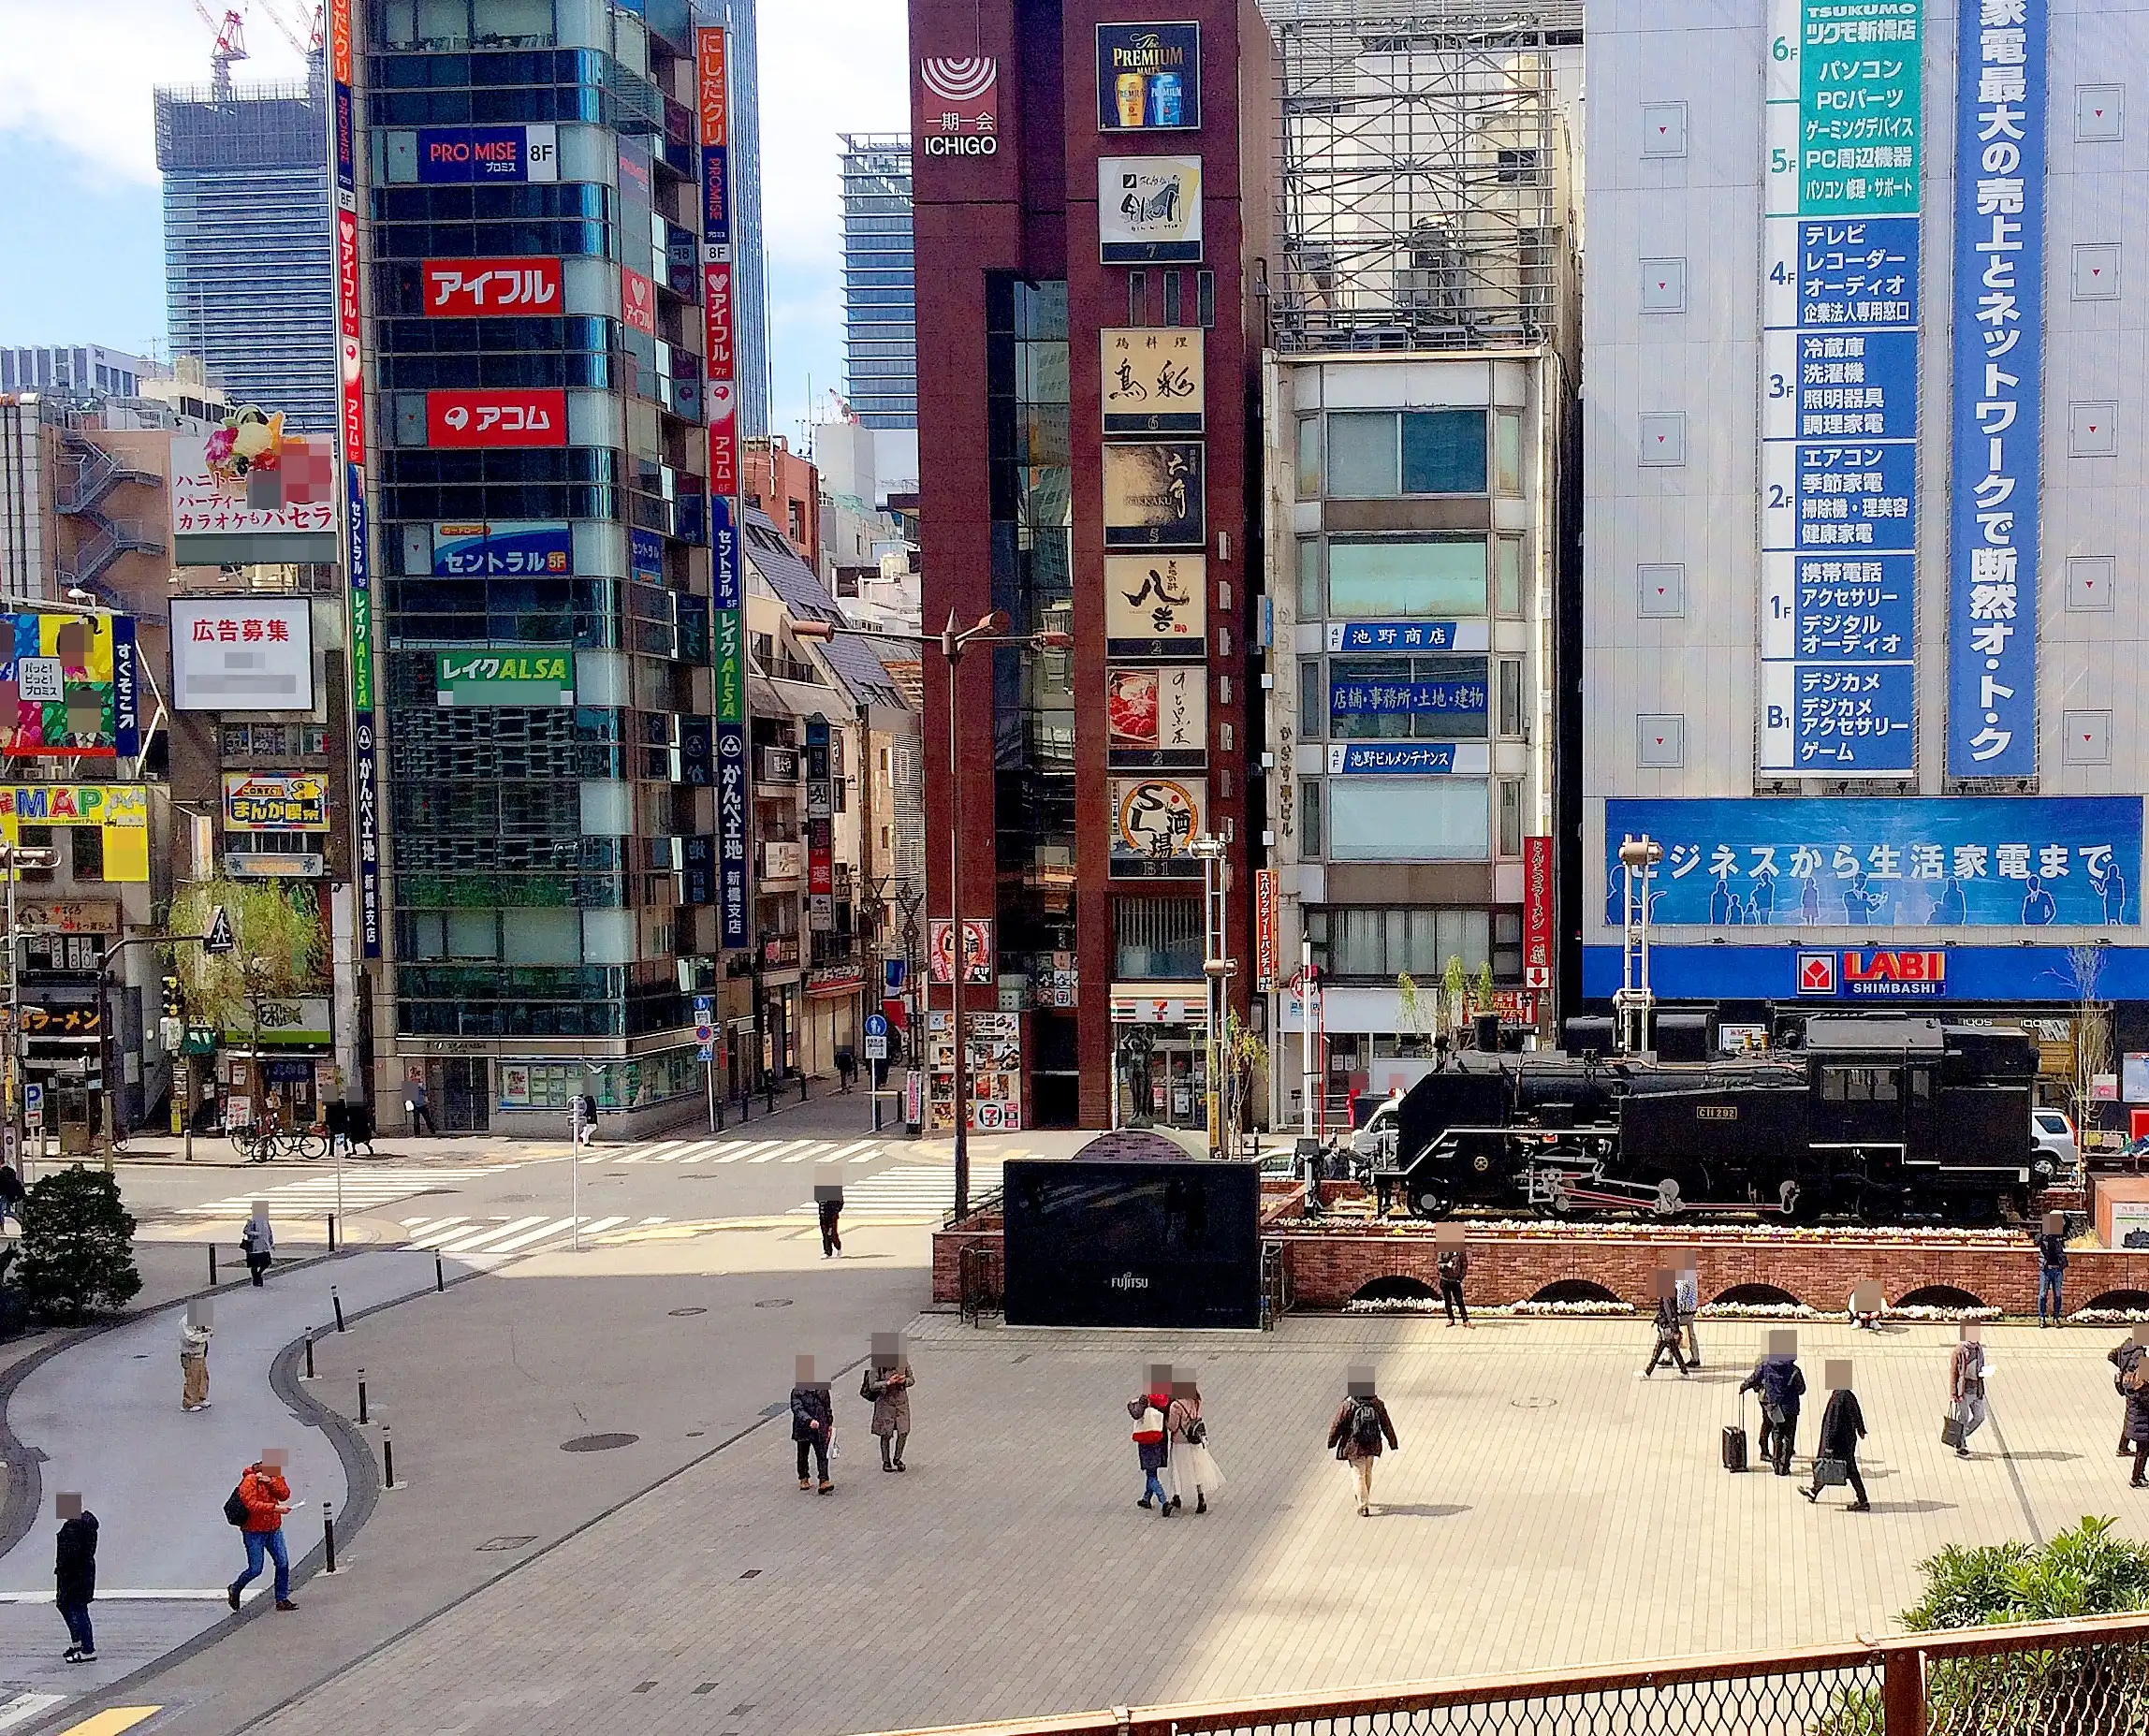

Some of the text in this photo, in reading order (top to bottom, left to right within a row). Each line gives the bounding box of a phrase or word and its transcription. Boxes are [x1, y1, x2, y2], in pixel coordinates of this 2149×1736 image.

[1807, 4, 1917, 19] TSUKUMO
[1806, 19, 1917, 45] ツクモ新橋店
[1113, 47, 1183, 67] PREMIUM
[1772, 36, 1798, 62] 6F
[1820, 61, 1904, 81] パソコン
[1818, 88, 1905, 110] PCパーツ
[926, 111, 994, 131] 一期一会
[1806, 118, 1914, 141] ゲーミングデバイス
[431, 142, 517, 162] PROMISE
[530, 144, 553, 162] 8F
[925, 136, 998, 156] ICHIGO
[1771, 148, 1797, 174] 5F
[1806, 146, 1913, 169] PC周辺機器
[1805, 224, 1866, 247] テレビ
[709, 246, 725, 260] 8F
[1806, 249, 1907, 272] レコーダー
[341, 243, 357, 319] アイフル
[1769, 260, 1796, 285] 4F
[431, 270, 555, 306] アイフル
[1805, 275, 1906, 298] オーディオ
[1804, 301, 1910, 324] 企業法人専用窓口
[710, 293, 731, 362] アイフル
[1804, 337, 1865, 359] 冷蔵庫
[1804, 363, 1865, 385] 洗濯機
[1769, 373, 1794, 399] 3F
[1804, 387, 1884, 410] 照明器具
[476, 405, 549, 431] アコム
[1148, 415, 1159, 430] 6
[1803, 412, 1884, 435] 調理家電
[715, 436, 731, 479] アコム
[1804, 448, 1883, 468] エアコン
[1802, 472, 1883, 495] 季節家電
[1767, 484, 1793, 509] 2F
[1802, 498, 1908, 520] 掃除機・理美容
[1801, 522, 1873, 545] 健康家電
[446, 551, 546, 573] セントラル
[549, 557, 564, 570] 5F
[718, 530, 737, 597] セントラル
[1801, 562, 1882, 584] 携帯電話
[1770, 595, 1792, 620] 1F
[1801, 588, 1908, 610] アクセサリー
[192, 618, 289, 643] 広告募集
[1802, 614, 1882, 635] デジタル
[1352, 627, 1450, 646] 池野商店
[1801, 635, 1901, 654] オーディオ
[117, 643, 134, 711] すぐそこ
[1802, 672, 1881, 693] デジカメ
[26, 686, 57, 697] プロミス
[1767, 704, 1790, 729] B1
[1802, 697, 1873, 717] デジカメ
[1801, 717, 1909, 737] アクセサリー
[1350, 751, 1450, 768] 池野ビルメンテナンス
[1801, 741, 1854, 762] ゲーム
[360, 757, 380, 862] かんべ土地
[723, 764, 743, 861] かんべ土地
[1843, 952, 1945, 981] LABI
[1853, 983, 1936, 994] SHIMBASHI
[1111, 1272, 1148, 1291] FUJITSU
